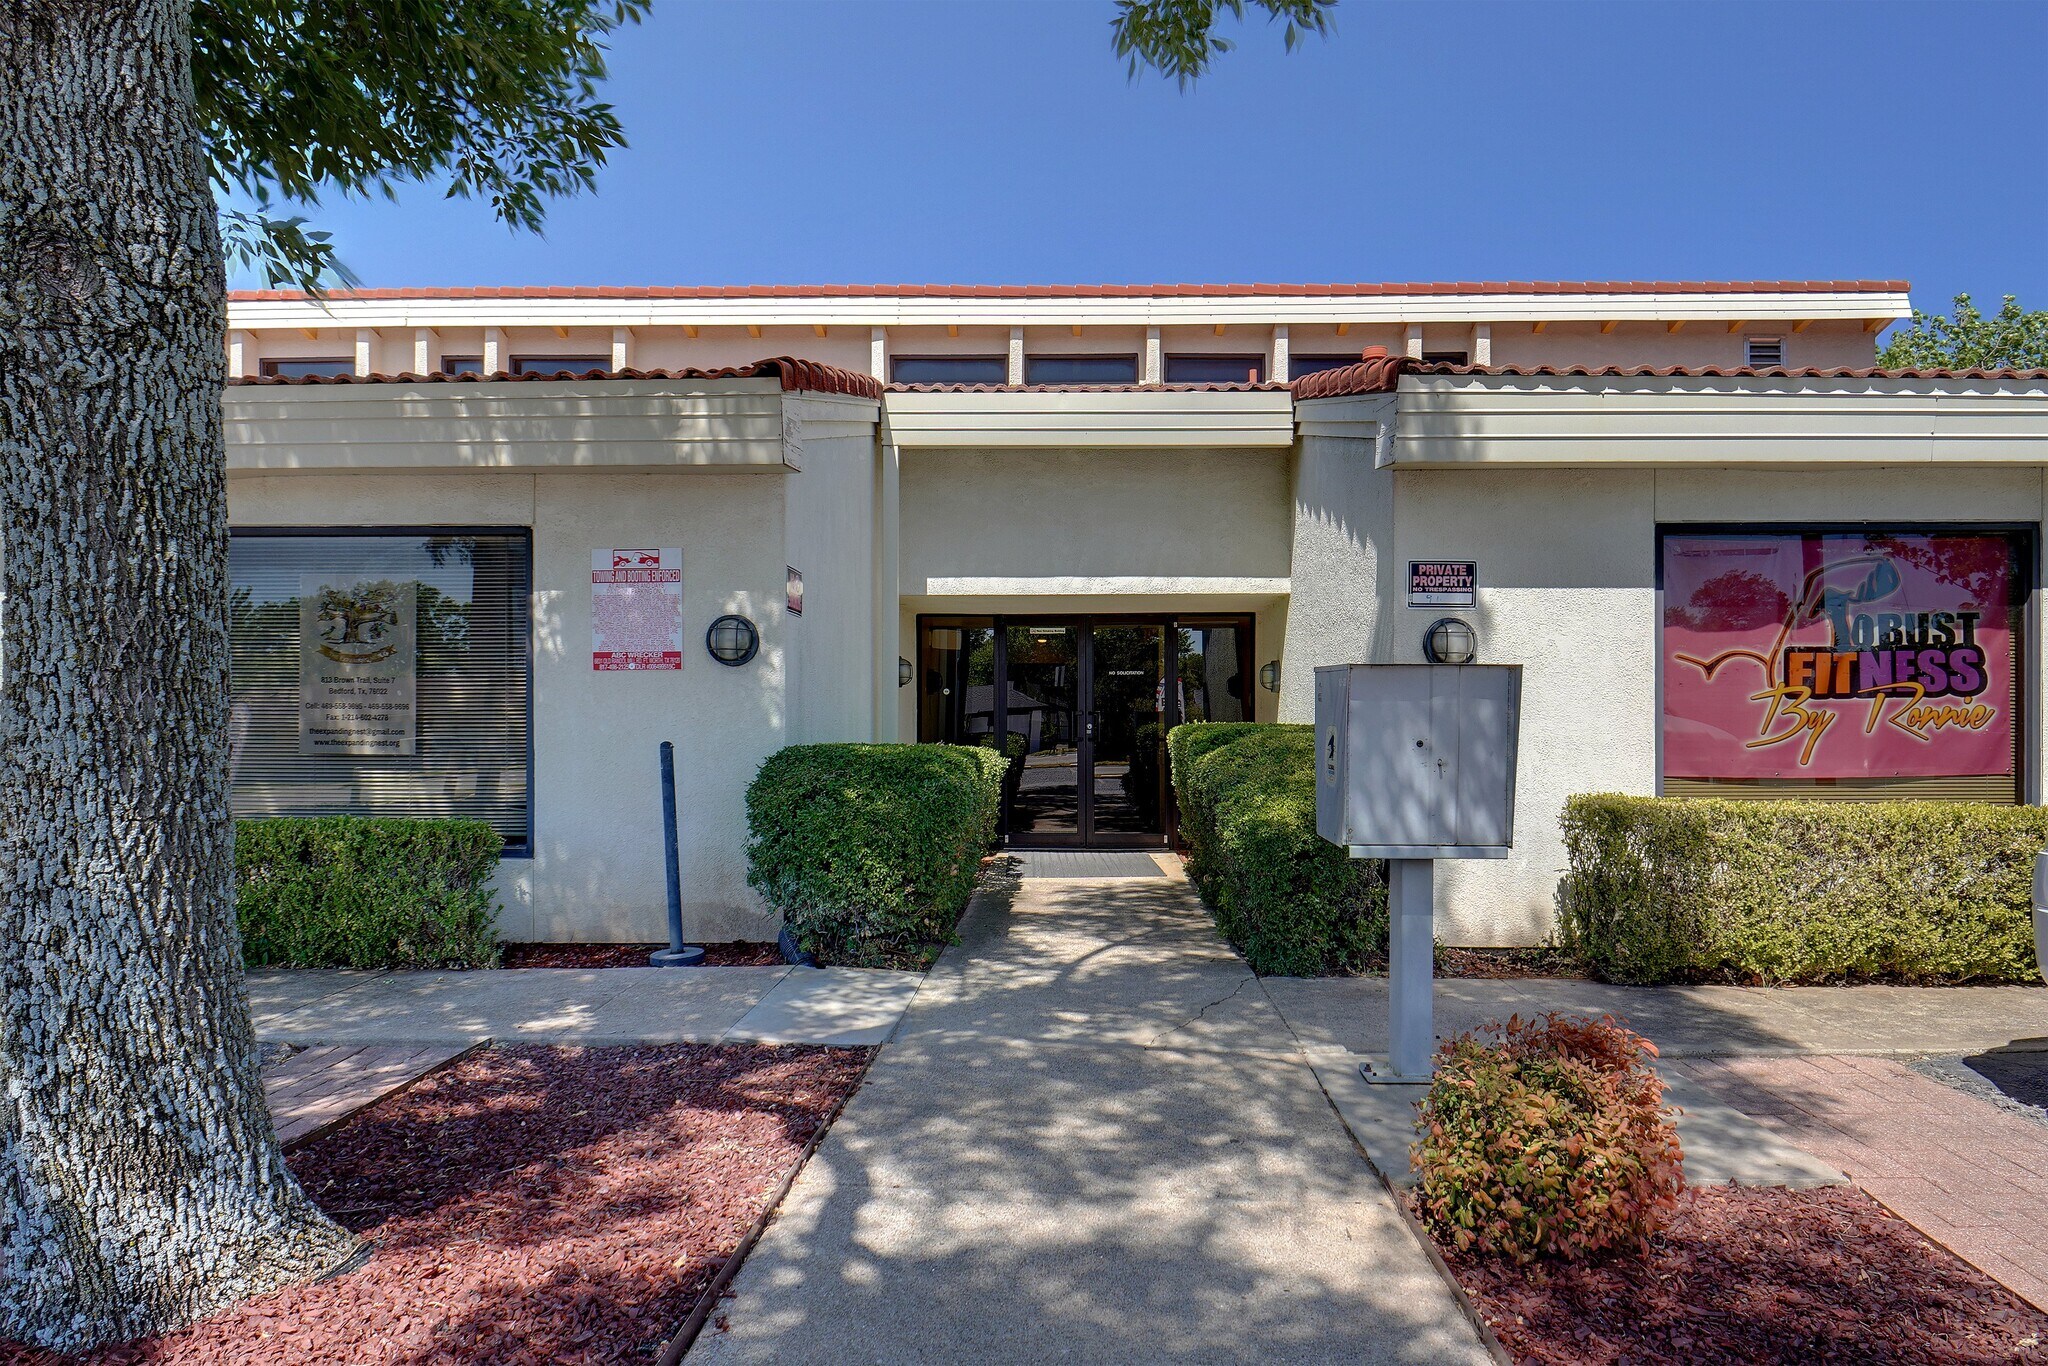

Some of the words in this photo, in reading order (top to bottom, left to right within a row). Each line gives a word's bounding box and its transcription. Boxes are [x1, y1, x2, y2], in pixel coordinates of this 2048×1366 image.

[1418, 564, 1467, 575] PRIVATE
[615, 570, 627, 582] AND
[651, 570, 680, 582] ENFORCED
[1412, 576, 1473, 587] PROPERTY
[1788, 649, 1981, 695] FITNESS
[356, 677, 372, 685] Trail,
[1746, 681, 1836, 766] By
[1857, 681, 1996, 742] Ronnie
[309, 728, 406, 736] theexpandingnest@gmail.com
[313, 740, 401, 748] www.theexpandingnest.org
